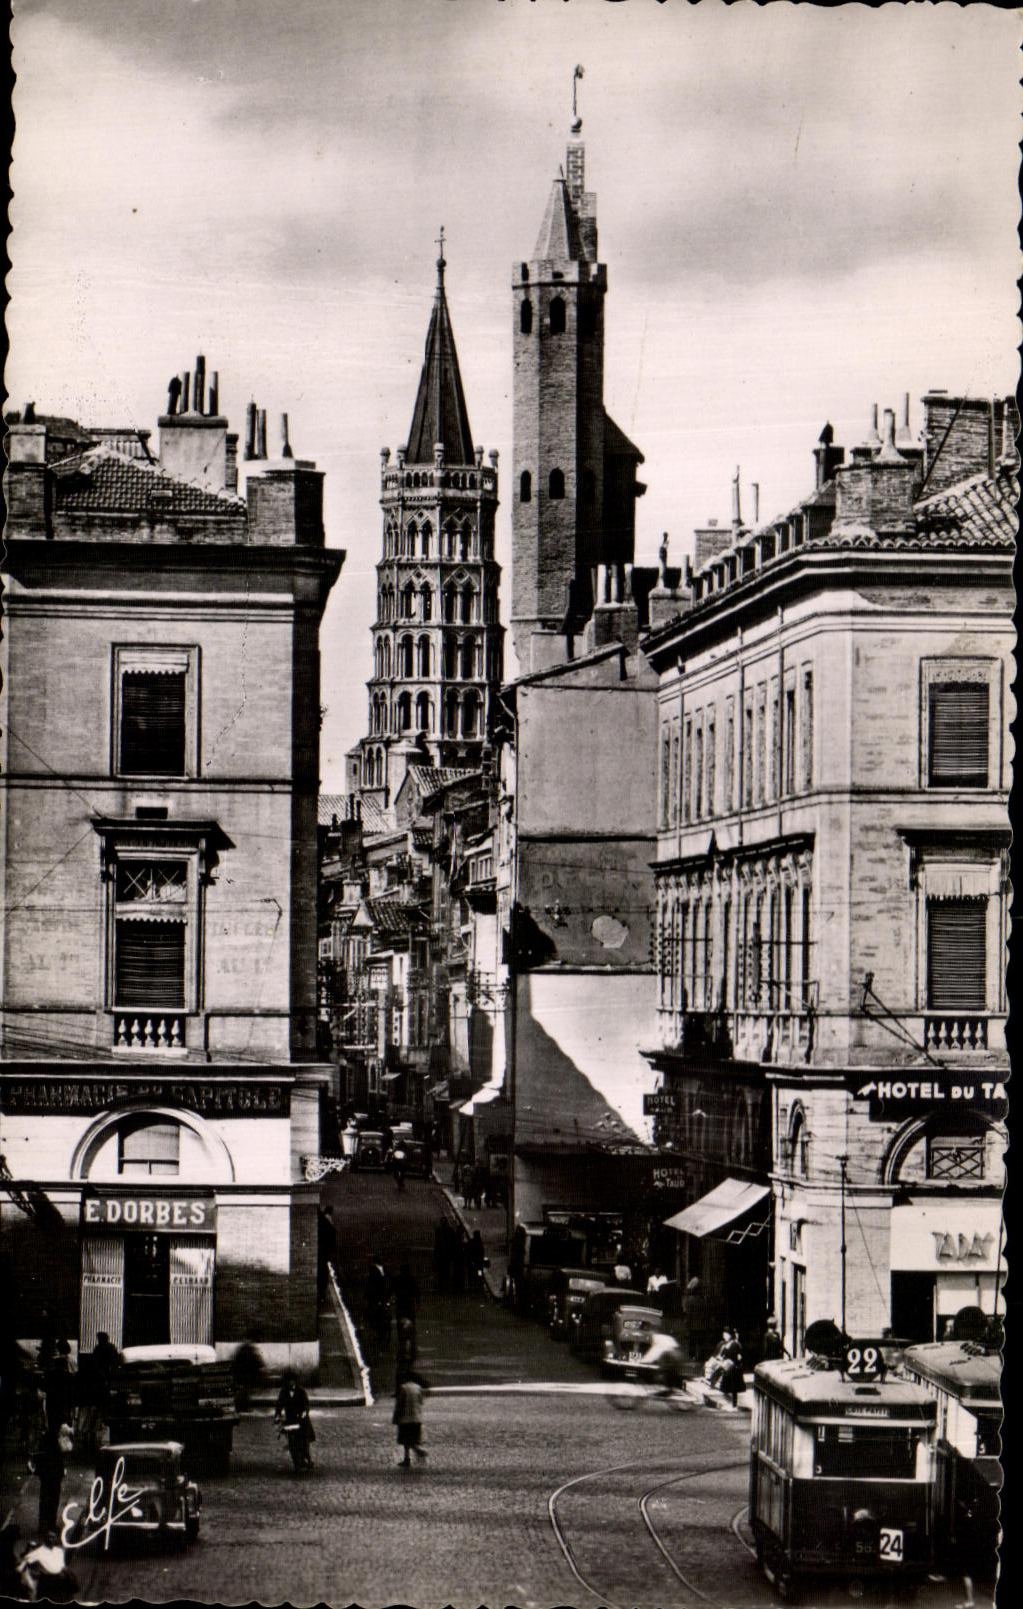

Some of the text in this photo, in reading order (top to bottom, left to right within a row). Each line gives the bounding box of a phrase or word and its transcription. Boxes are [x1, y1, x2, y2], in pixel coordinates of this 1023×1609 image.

[647, 1095, 676, 1106] HOTEL
[877, 1082, 945, 1099] HOTEL
[951, 1086, 975, 1099] DU
[653, 1168, 685, 1180] HOTEL
[106, 1200, 206, 1225] DORBES
[847, 1348, 878, 1374] 22
[879, 1533, 903, 1557] 24
